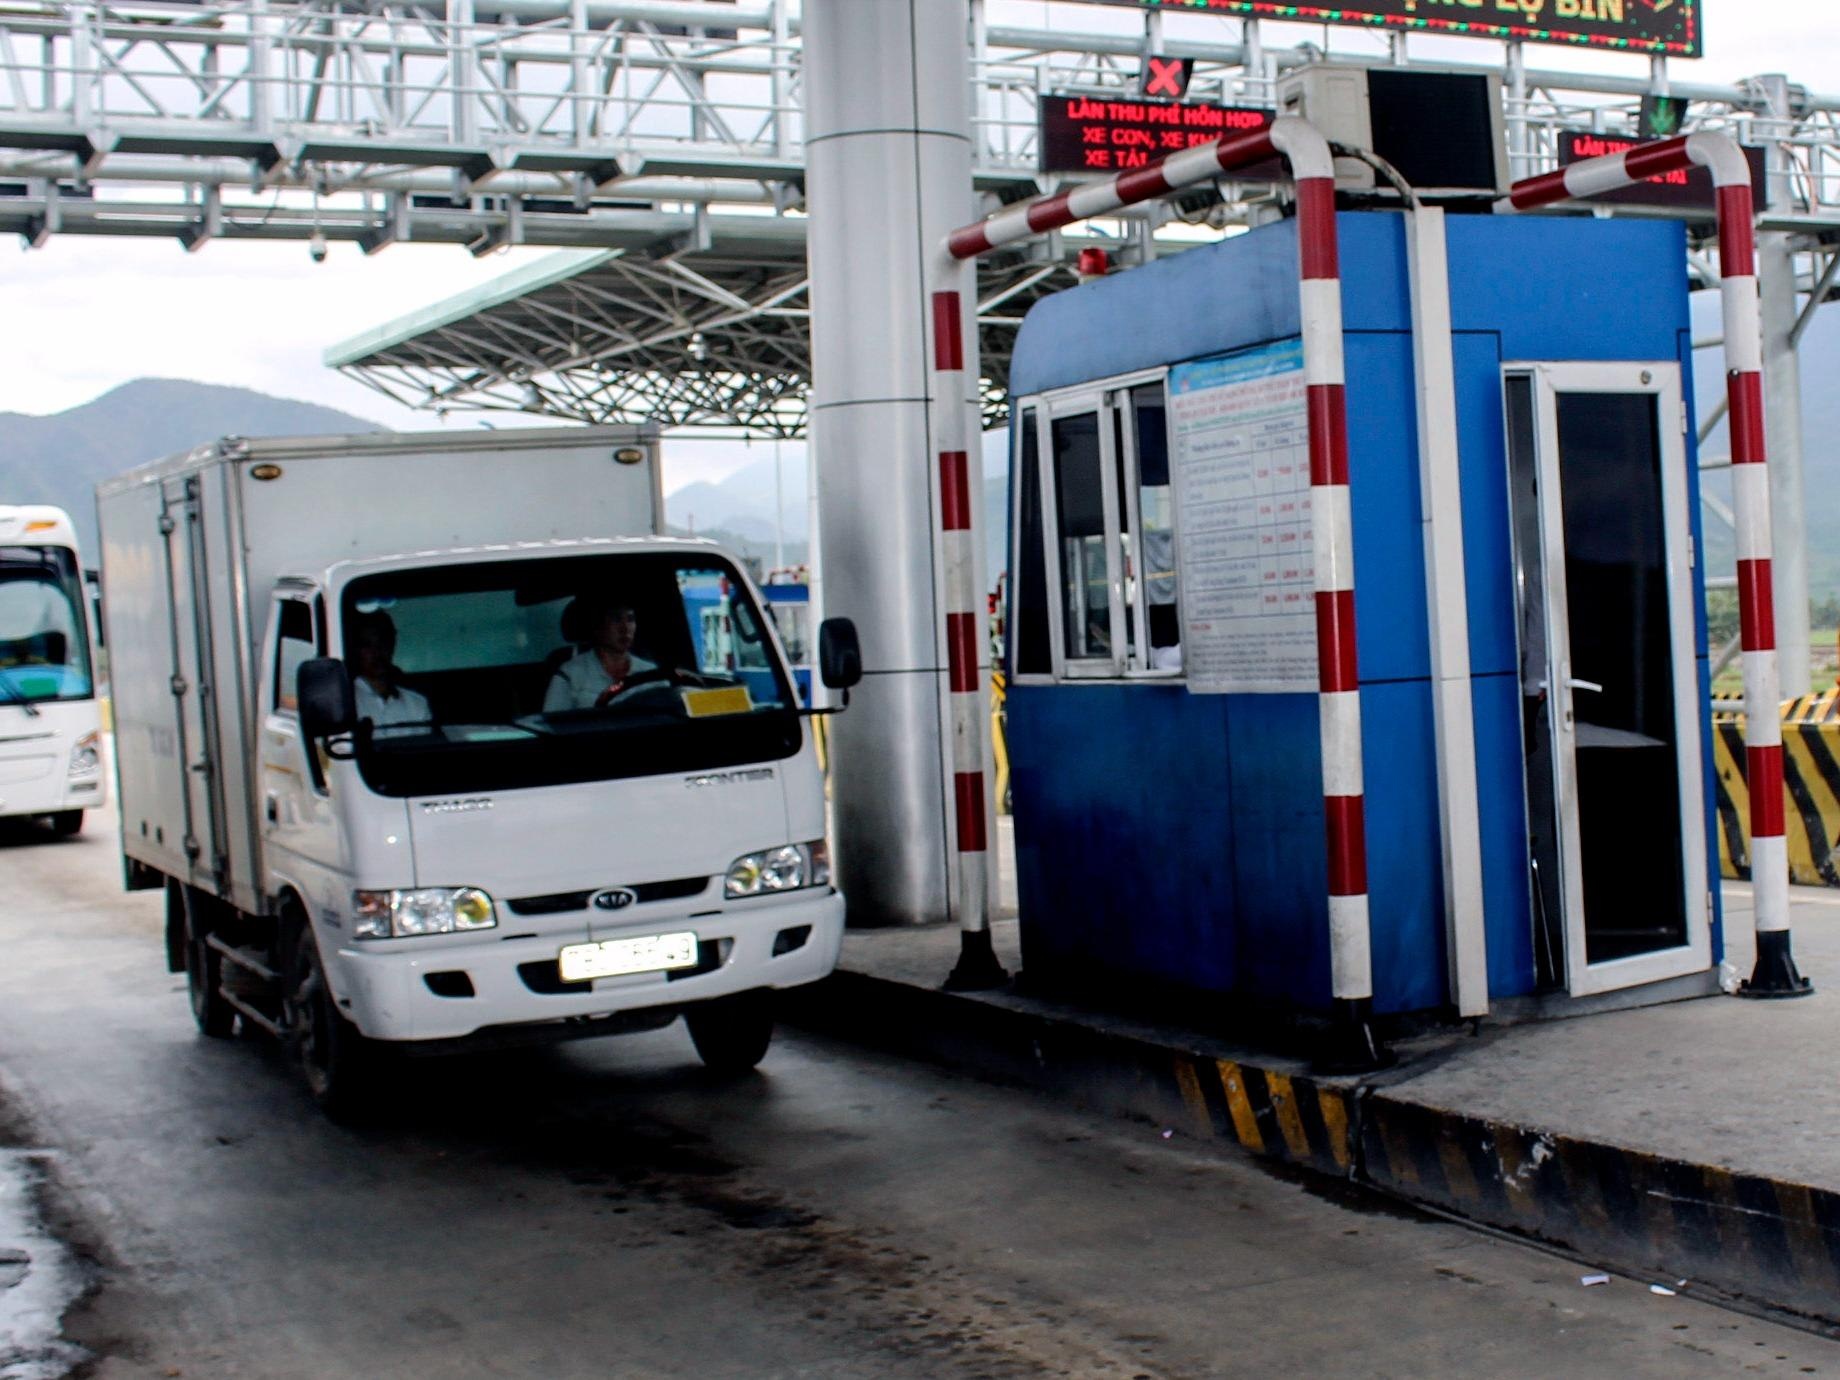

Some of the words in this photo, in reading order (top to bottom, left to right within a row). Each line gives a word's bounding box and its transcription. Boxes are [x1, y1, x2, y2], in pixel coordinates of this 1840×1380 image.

[1108, 103, 1144, 121] THU
[1148, 103, 1180, 124] PHÍ
[1082, 126, 1107, 144] XE
[1161, 131, 1184, 149] XE
[1085, 149, 1110, 167] XE
